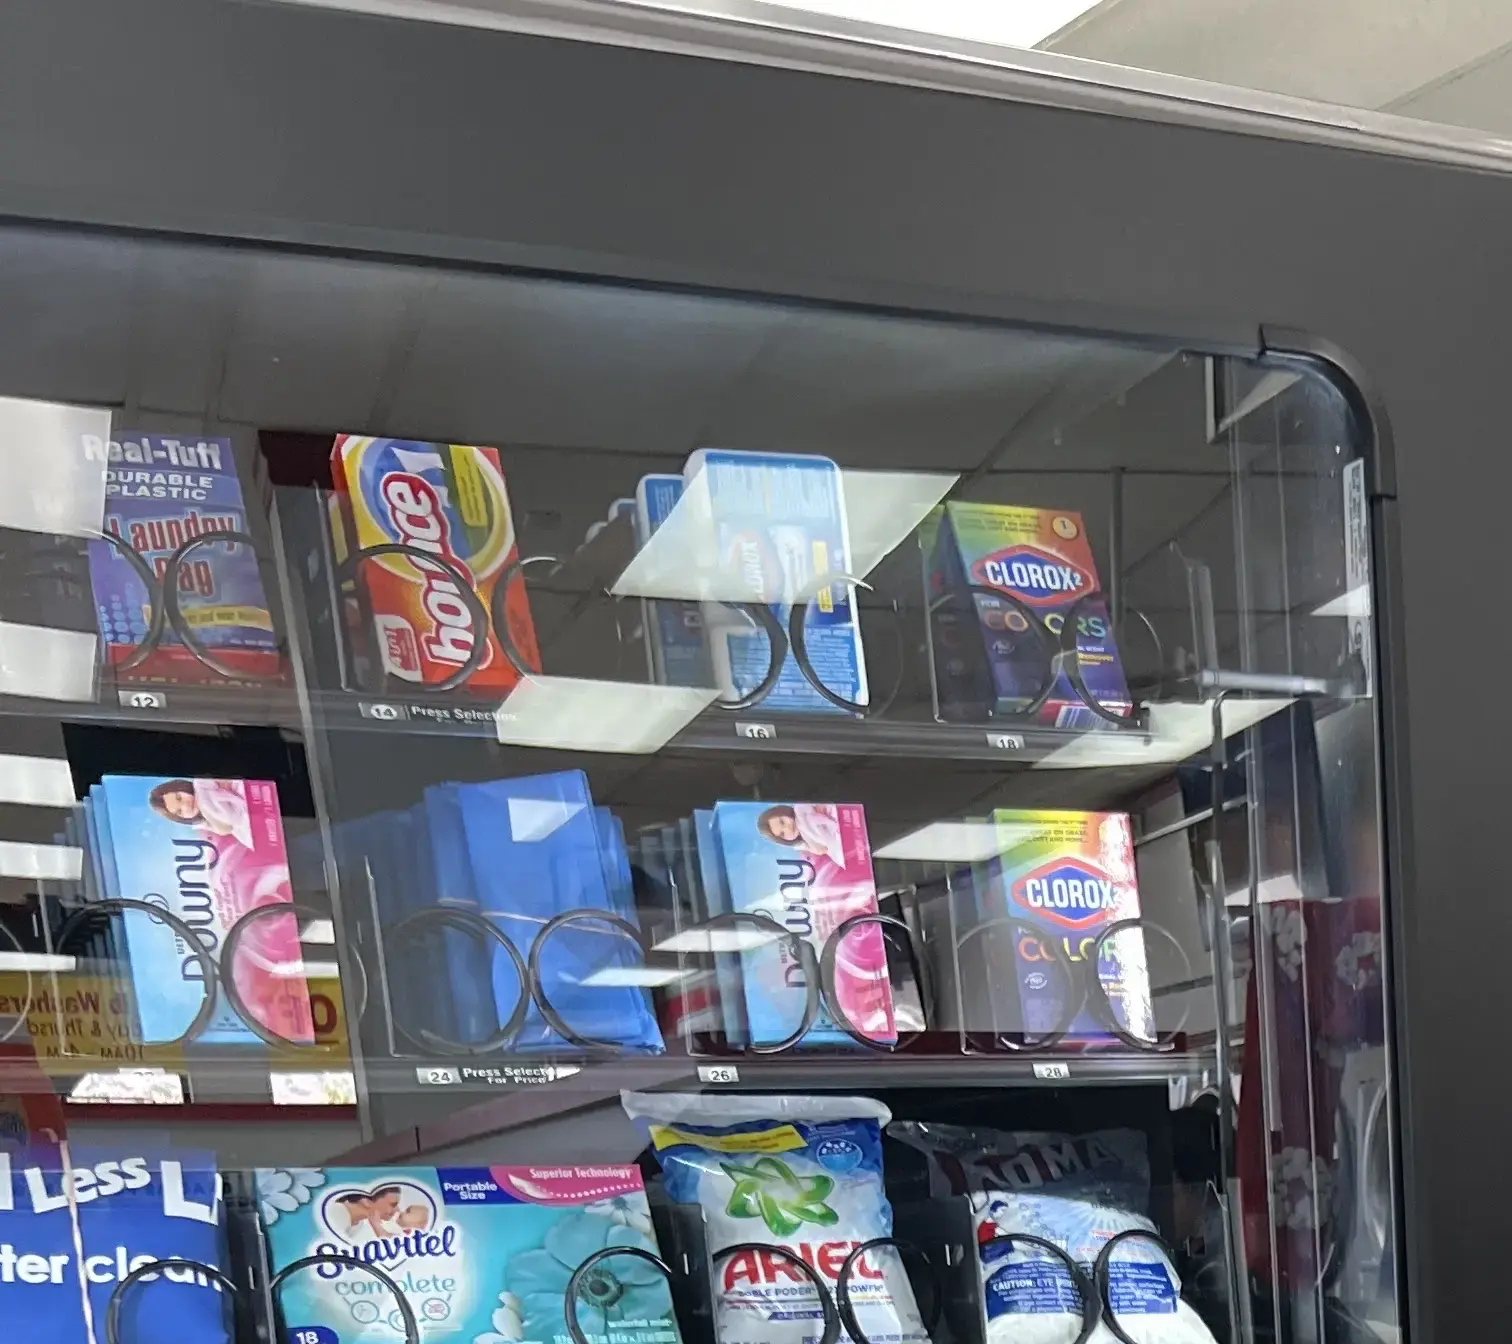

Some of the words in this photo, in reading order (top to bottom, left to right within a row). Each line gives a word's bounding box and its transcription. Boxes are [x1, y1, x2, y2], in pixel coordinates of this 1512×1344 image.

[81, 434, 222, 470] Real-Tuff
[102, 470, 213, 489] DURABLE
[107, 485, 207, 500] PLASTIC
[108, 511, 236, 554] Laundry
[412, 705, 449, 719] Press
[429, 1070, 451, 1083] 24
[464, 1067, 500, 1079] Press
[712, 1070, 729, 1081] 26
[1046, 1067, 1062, 1078] 28
[531, 1168, 572, 1180] Superior
[575, 1167, 631, 1180] Technology
[26, 1156, 153, 1214] Less
[444, 1181, 497, 1193] Portable
[460, 1189, 486, 1200] Size
[316, 1225, 456, 1279] Suavitel
[724, 1241, 884, 1291] ARIEL
[297, 1332, 318, 1344] 18
